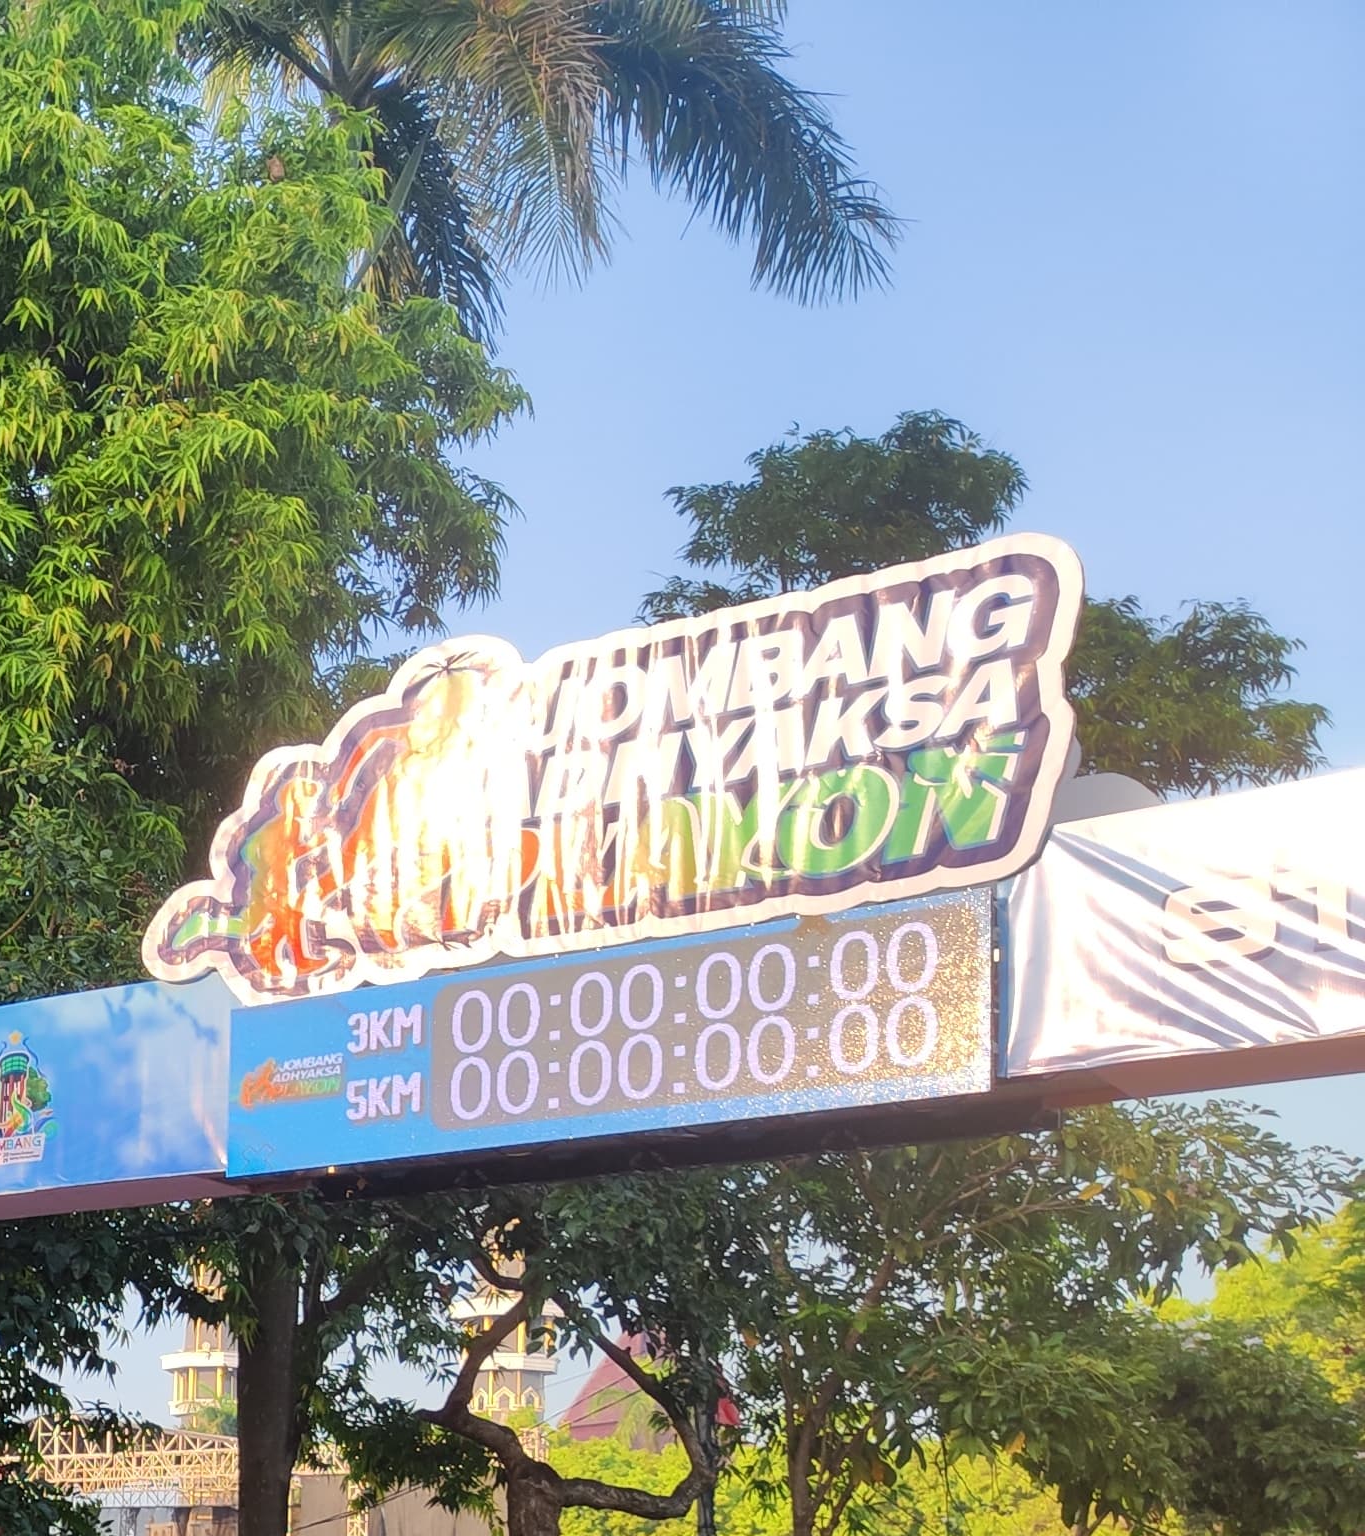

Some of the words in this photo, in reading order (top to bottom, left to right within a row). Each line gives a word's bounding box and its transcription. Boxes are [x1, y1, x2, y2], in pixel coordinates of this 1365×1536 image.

[525, 573, 1037, 755] JOMBANG
[347, 1004, 422, 1054] 3KM
[451, 921, 938, 1054] 00:00:00:00
[273, 1065, 341, 1083] ADHYAKSA
[278, 1053, 343, 1072] JOMBANG
[346, 1072, 421, 1121] 5KM
[450, 996, 938, 1120] 00:00:00:00
